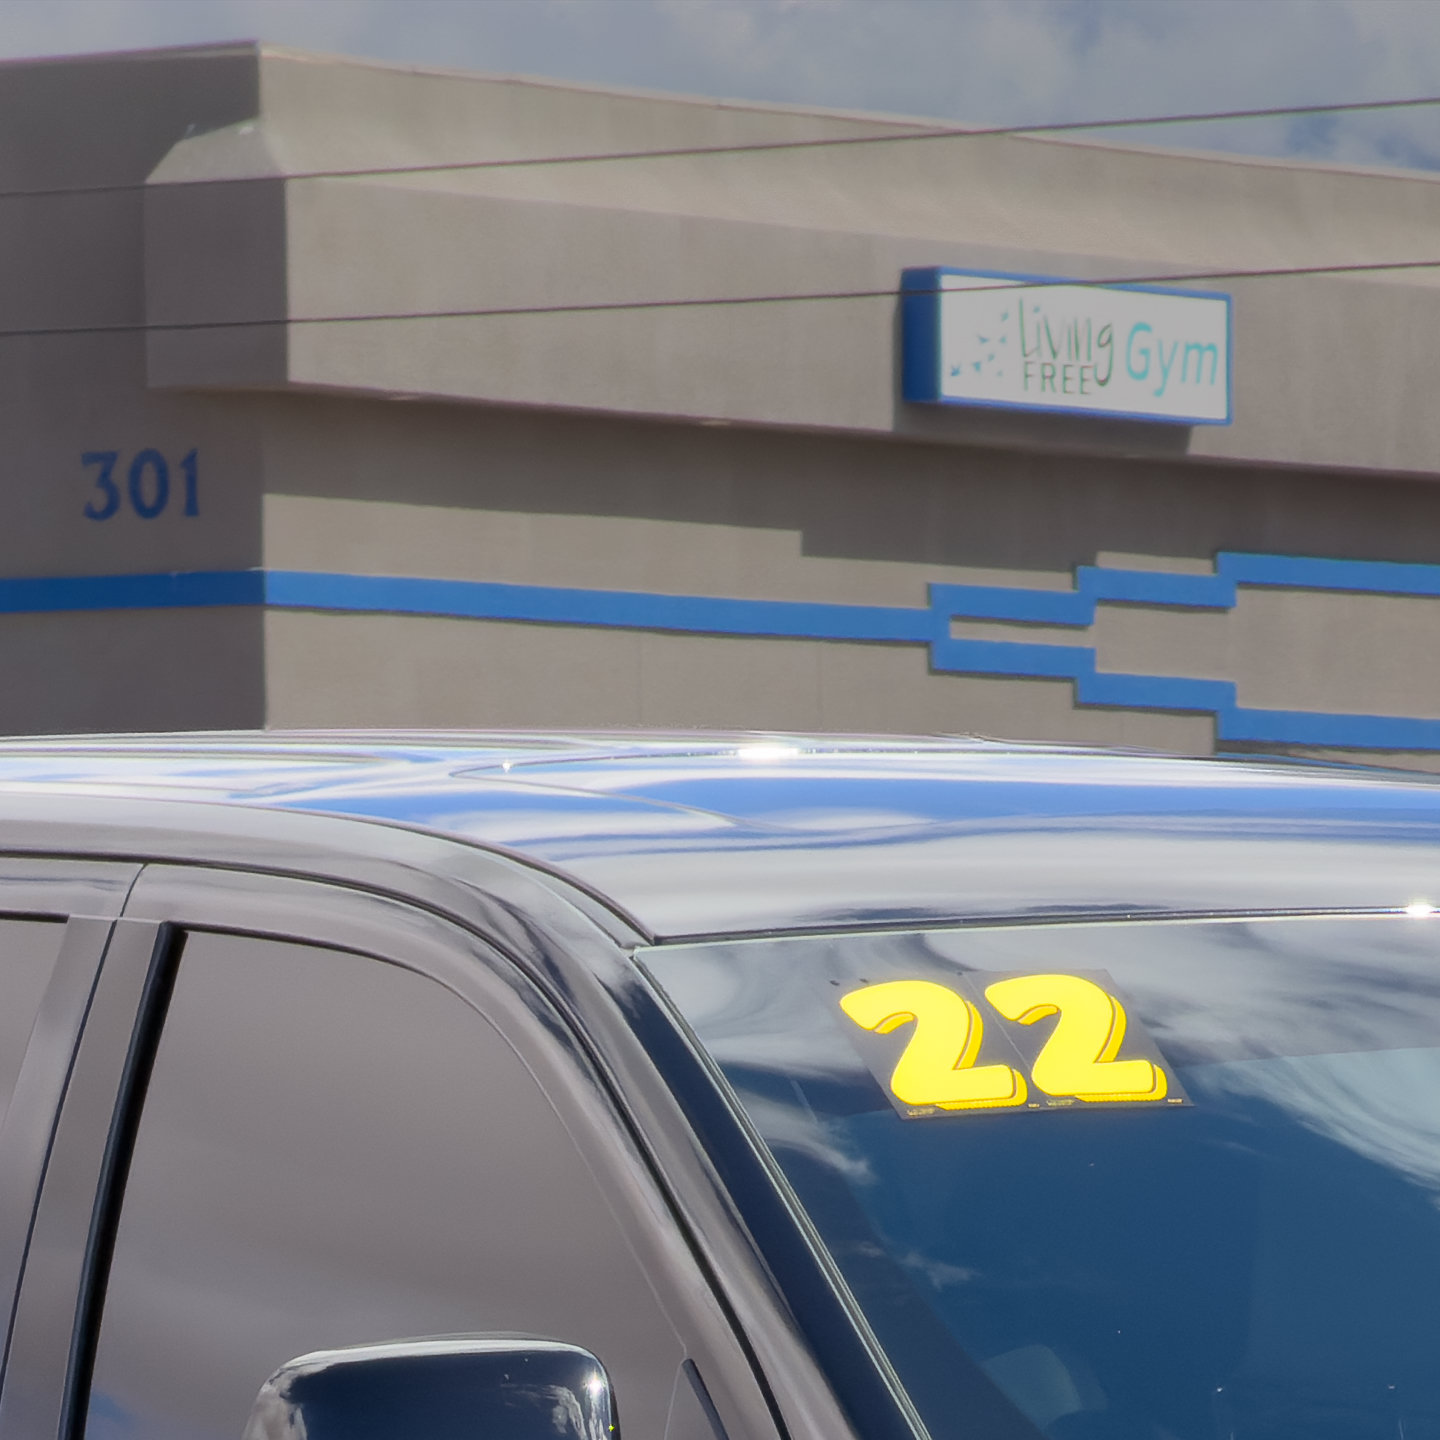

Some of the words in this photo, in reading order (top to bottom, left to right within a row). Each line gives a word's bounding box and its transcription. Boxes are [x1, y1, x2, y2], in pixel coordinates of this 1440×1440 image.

[1022, 360, 1093, 396] FREE
[1126, 321, 1219, 398] Gym
[80, 447, 201, 521] 301
[839, 973, 1168, 1111] 22
